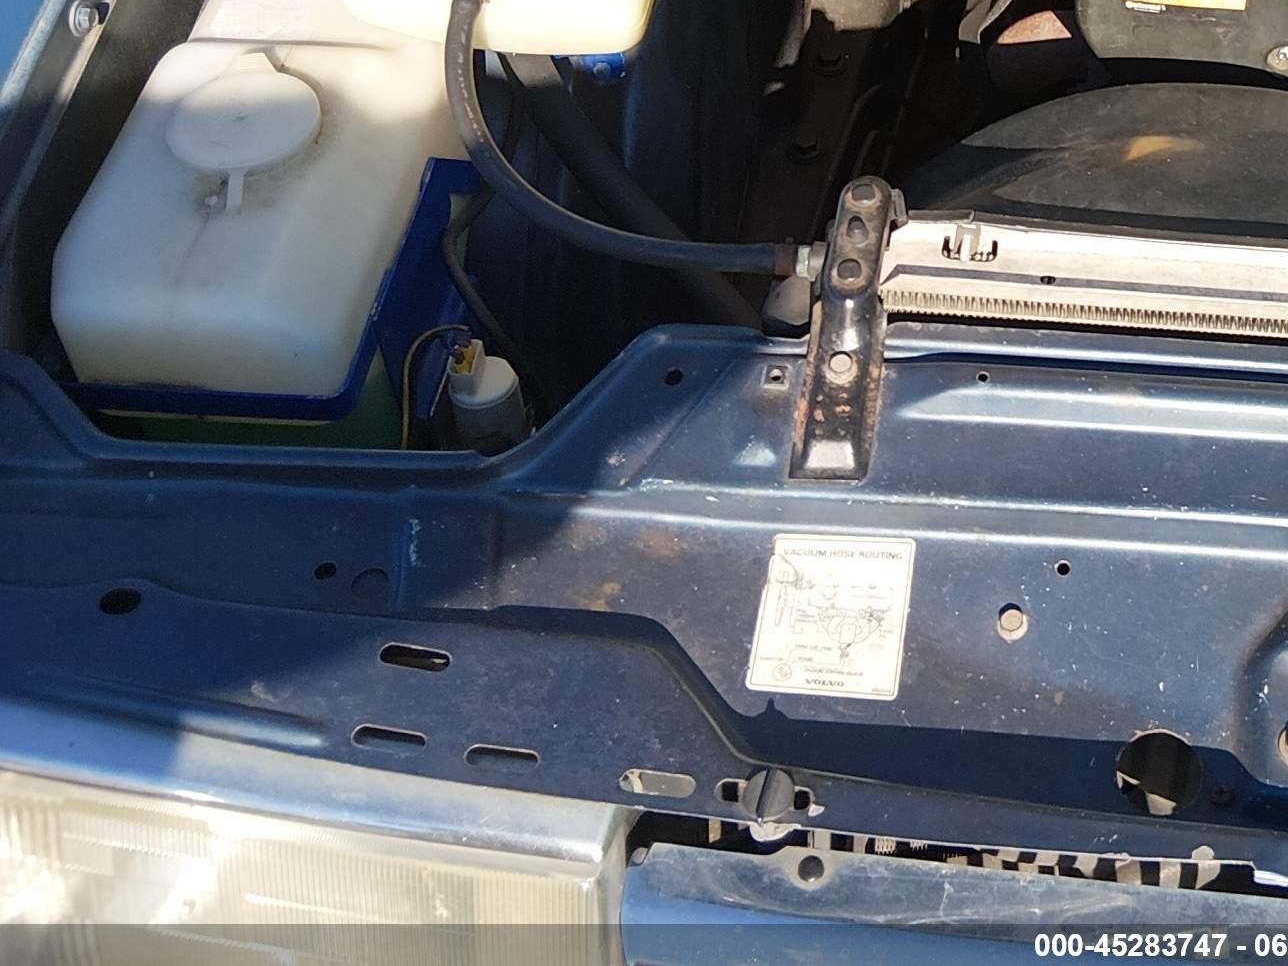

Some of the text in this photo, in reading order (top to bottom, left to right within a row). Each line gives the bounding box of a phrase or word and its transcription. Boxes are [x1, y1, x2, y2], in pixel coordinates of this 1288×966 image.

[783, 548, 904, 561] VACUUM HOSE ROUTING
[805, 678, 845, 687] VOLVO
